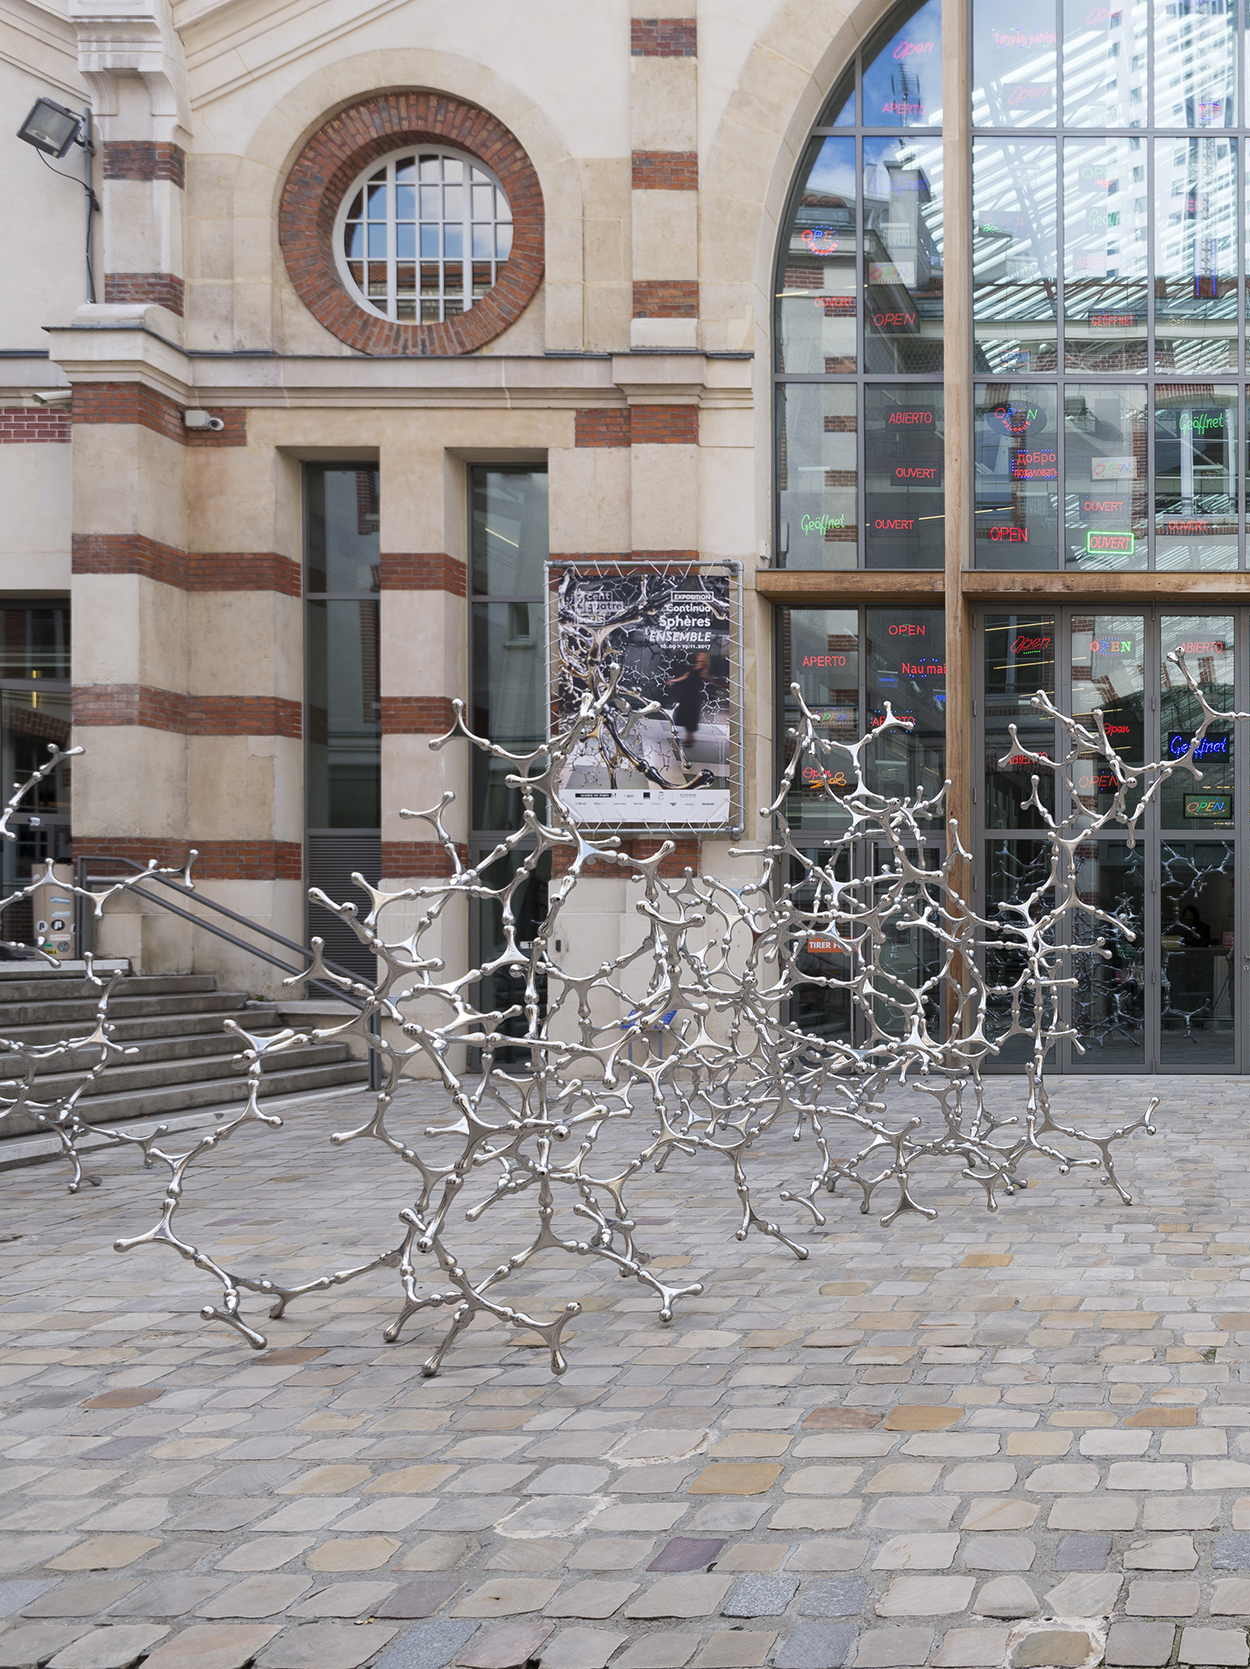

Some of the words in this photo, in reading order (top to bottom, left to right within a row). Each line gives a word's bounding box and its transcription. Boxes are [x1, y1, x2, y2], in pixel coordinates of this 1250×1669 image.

[893, 41, 934, 60] Open
[1008, 86, 1048, 105] Open
[882, 103, 926, 115] APERTO
[1082, 166, 1125, 179] OPEN
[1167, 199, 1203, 211] OPEN
[1076, 256, 1120, 269] ABIERTO
[871, 268, 908, 280] OPEN
[814, 296, 854, 307] OUVERT
[873, 313, 916, 326] OPEN
[1091, 314, 1134, 327] GEÖFFNET
[999, 352, 1030, 364] OPEN
[888, 412, 932, 424] ABIERTO
[994, 407, 1038, 420] OPEN
[1179, 413, 1224, 435] Geöffnet
[895, 467, 936, 479] OUVERT
[1094, 463, 1129, 474] OPEN
[1084, 501, 1124, 511] OUVERT
[801, 513, 845, 535] Geöffnet
[875, 519, 914, 530] OUVERT
[1168, 520, 1208, 531] OUVERT
[990, 527, 1028, 542] OPEN
[1090, 536, 1132, 549] OUVERT
[659, 615, 711, 630] Sphères
[650, 631, 711, 642] ENSEMBLE
[888, 625, 925, 636] OPEN
[1010, 636, 1050, 653] Open
[1090, 640, 1132, 653] OPEN
[1181, 641, 1223, 653] ABIERTO
[802, 656, 846, 667] APERTO
[902, 663, 924, 674] Nau
[1103, 722, 1130, 736] Open
[1170, 735, 1227, 759] Geffnet
[1079, 775, 1118, 788] OPEN
[1186, 801, 1224, 812] OPEN
